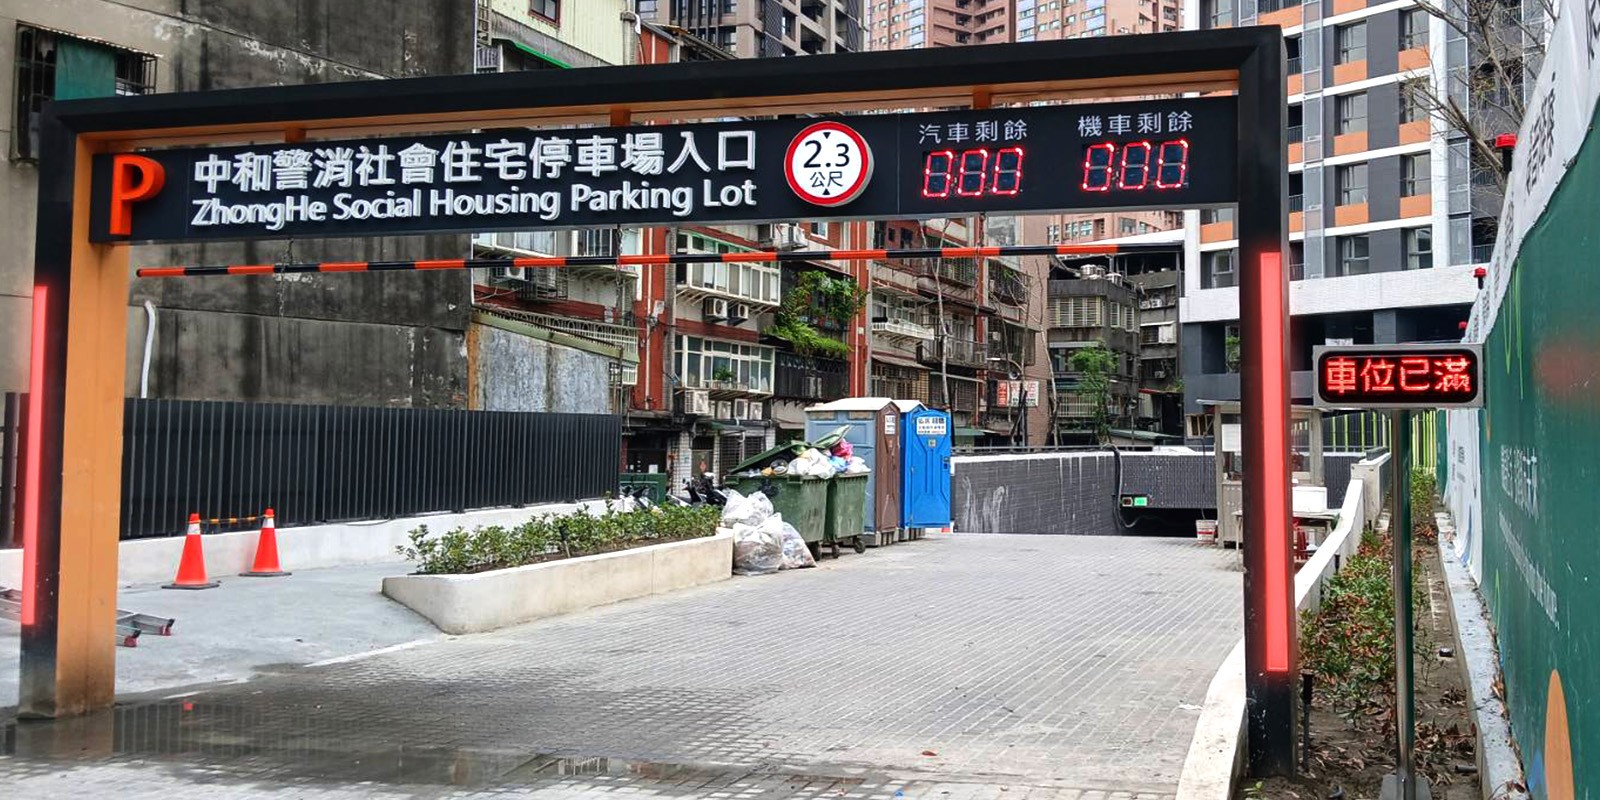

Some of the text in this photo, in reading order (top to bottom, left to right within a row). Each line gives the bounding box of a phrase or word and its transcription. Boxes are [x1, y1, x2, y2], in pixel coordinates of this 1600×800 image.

[919, 119, 1028, 144] 汽車剩餘
[1077, 110, 1194, 138] 機車剩餘
[193, 129, 757, 193] 中和警消社會住宅停車場入口
[803, 139, 850, 169] 2.3
[109, 154, 166, 236] P
[809, 170, 844, 188] 公尺
[190, 178, 757, 231] ZhongHe Social Housing Parking Lot
[1326, 356, 1472, 394] 車位已滿
